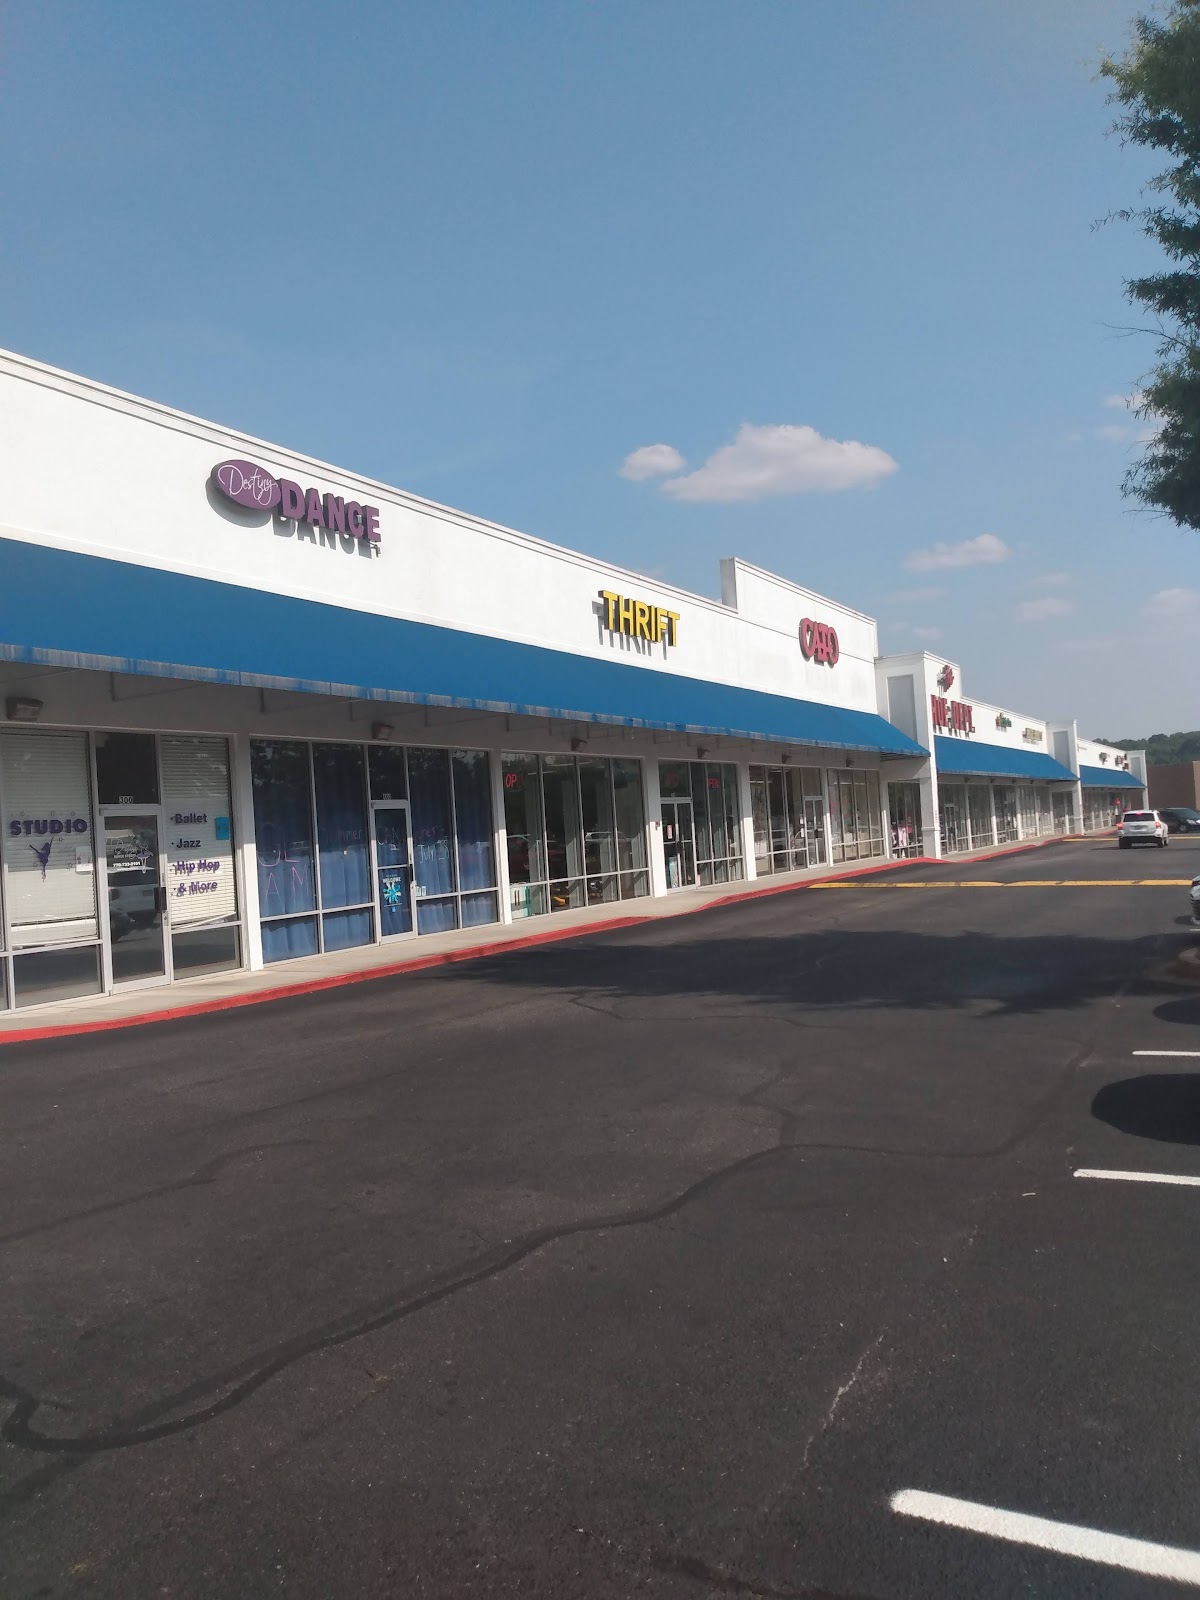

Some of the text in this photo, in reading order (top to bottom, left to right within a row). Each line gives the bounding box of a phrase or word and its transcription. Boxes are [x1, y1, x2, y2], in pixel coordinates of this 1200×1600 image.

[217, 465, 381, 542] Destiny DANCE
[600, 590, 680, 647] THRIFT
[799, 617, 839, 665] CATO
[174, 813, 208, 824] Ballet
[9, 818, 88, 836] STUDIO
[176, 838, 202, 849] Jazz
[176, 859, 220, 873] Hip Hop
[177, 881, 218, 893] & More
